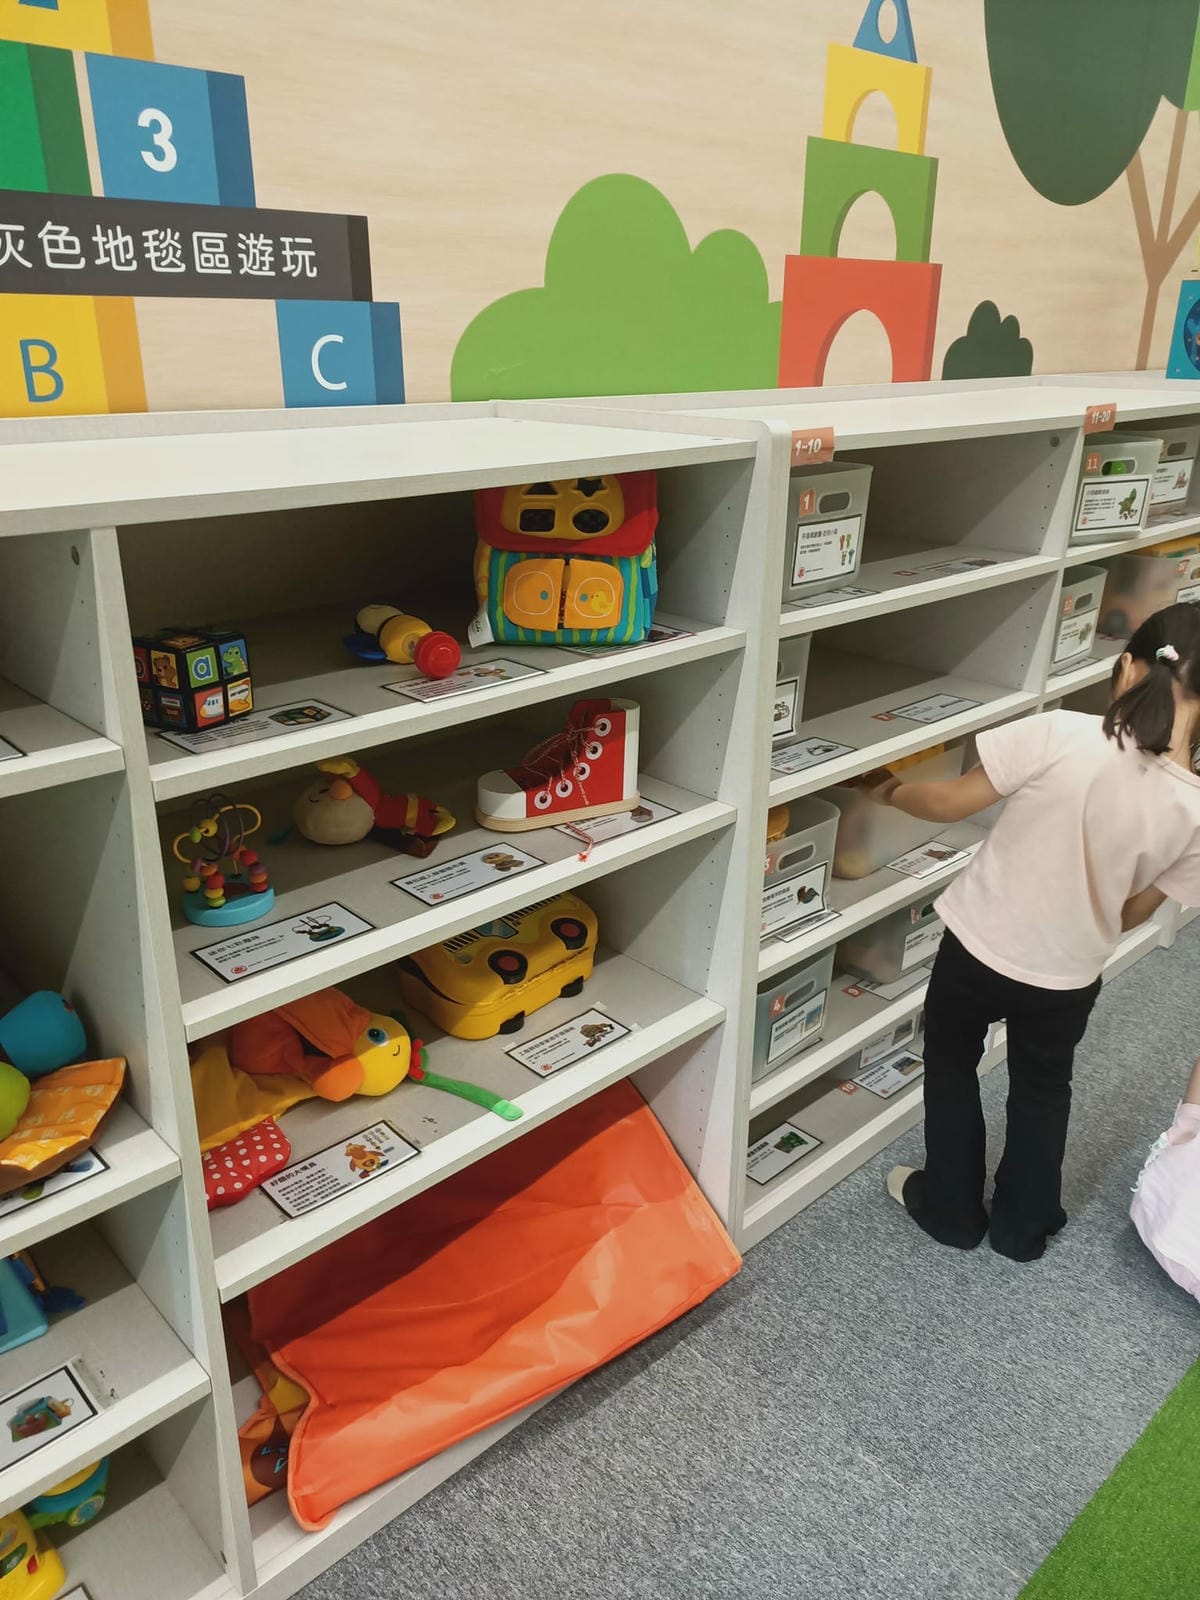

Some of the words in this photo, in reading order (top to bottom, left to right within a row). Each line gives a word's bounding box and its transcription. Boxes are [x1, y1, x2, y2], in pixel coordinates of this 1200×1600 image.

[137, 107, 178, 172] 3
[0, 220, 319, 278] 灰色地毯區遊玩
[19, 338, 65, 402] B
[310, 334, 348, 391] C
[1087, 458, 1099, 471] 11
[803, 494, 811, 511] 1
[192, 655, 213, 681] a
